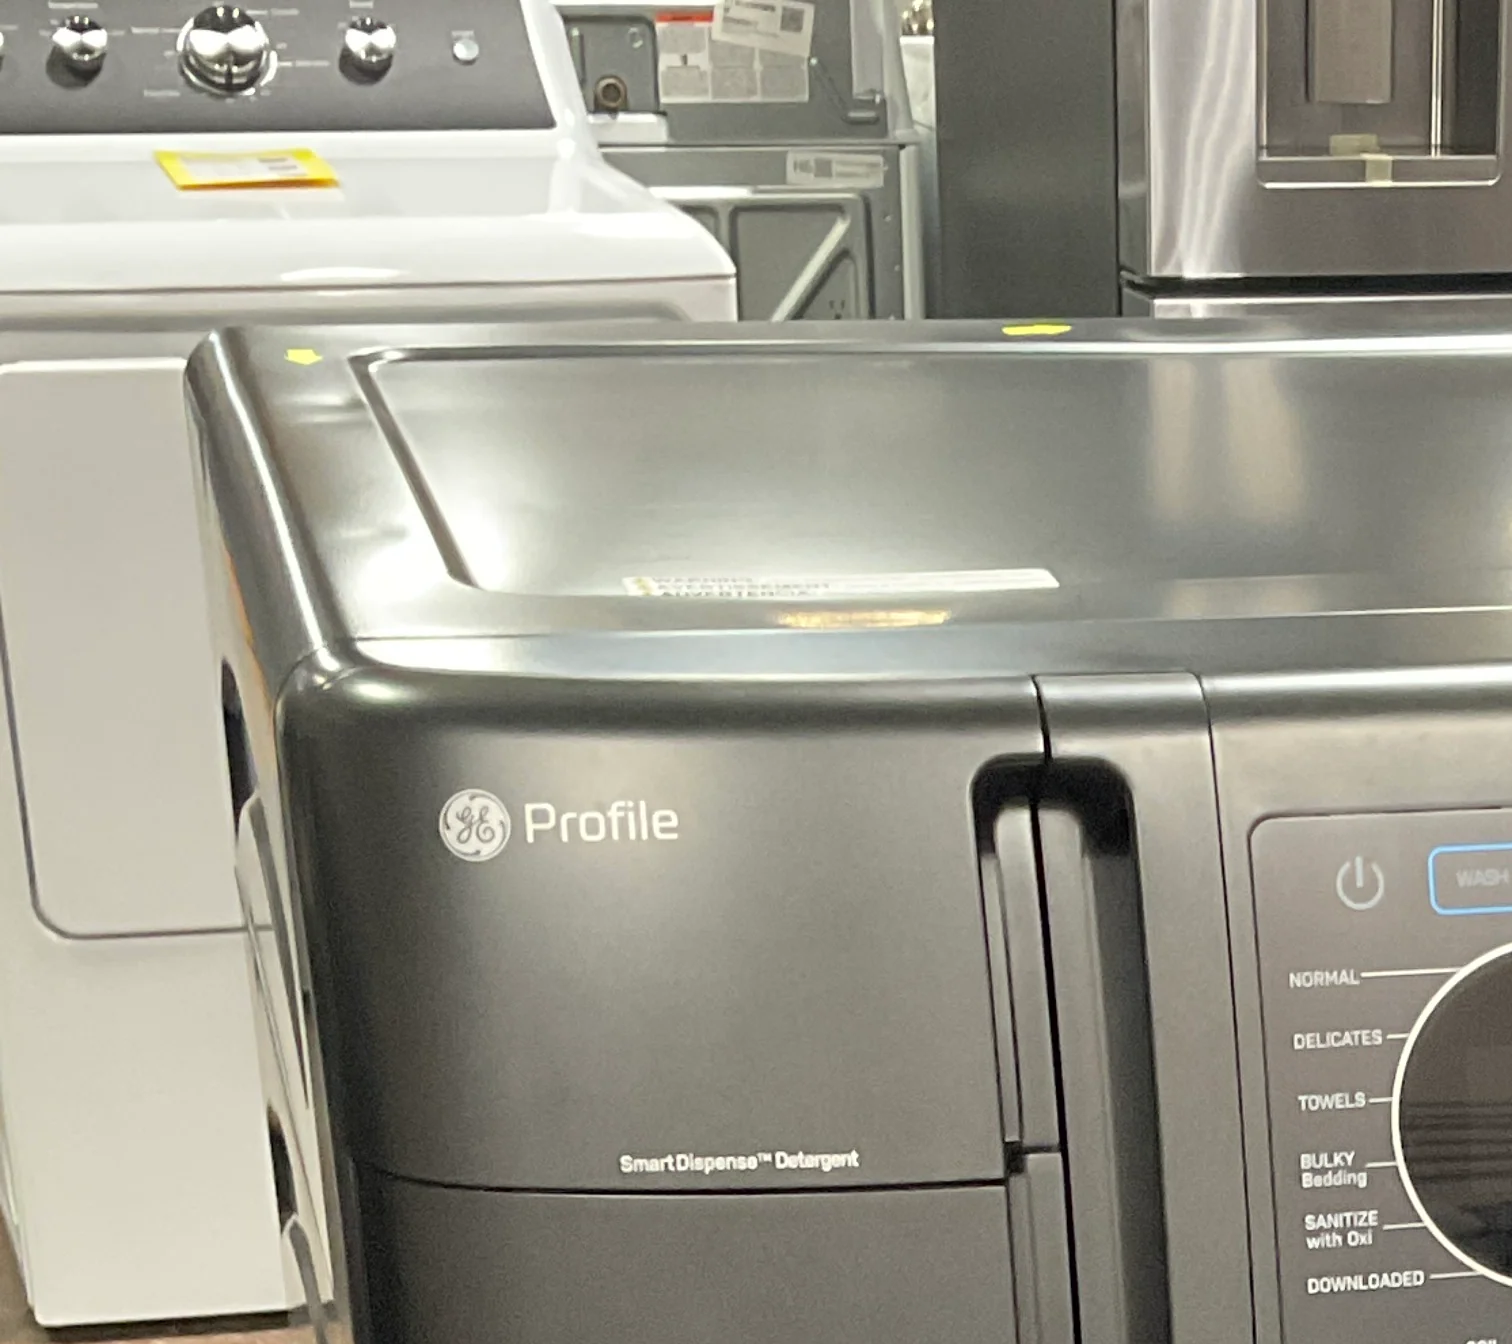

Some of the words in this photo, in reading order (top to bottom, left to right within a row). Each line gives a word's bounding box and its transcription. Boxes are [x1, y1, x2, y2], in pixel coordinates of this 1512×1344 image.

[524, 800, 679, 843] Profile
[1455, 868, 1510, 888] WASH
[1289, 969, 1360, 988] NORMAL
[1293, 1029, 1383, 1050] DELICATES
[1298, 1092, 1366, 1111] TOWELS
[774, 1150, 860, 1172] Detergent
[1300, 1151, 1355, 1170] BULKY
[1302, 1168, 1368, 1189] Bedding
[1304, 1210, 1379, 1231] SANITIZE
[1306, 1229, 1343, 1249] with
[1346, 1227, 1373, 1246] Oxi
[1307, 1270, 1426, 1295] DOWNLOADED
